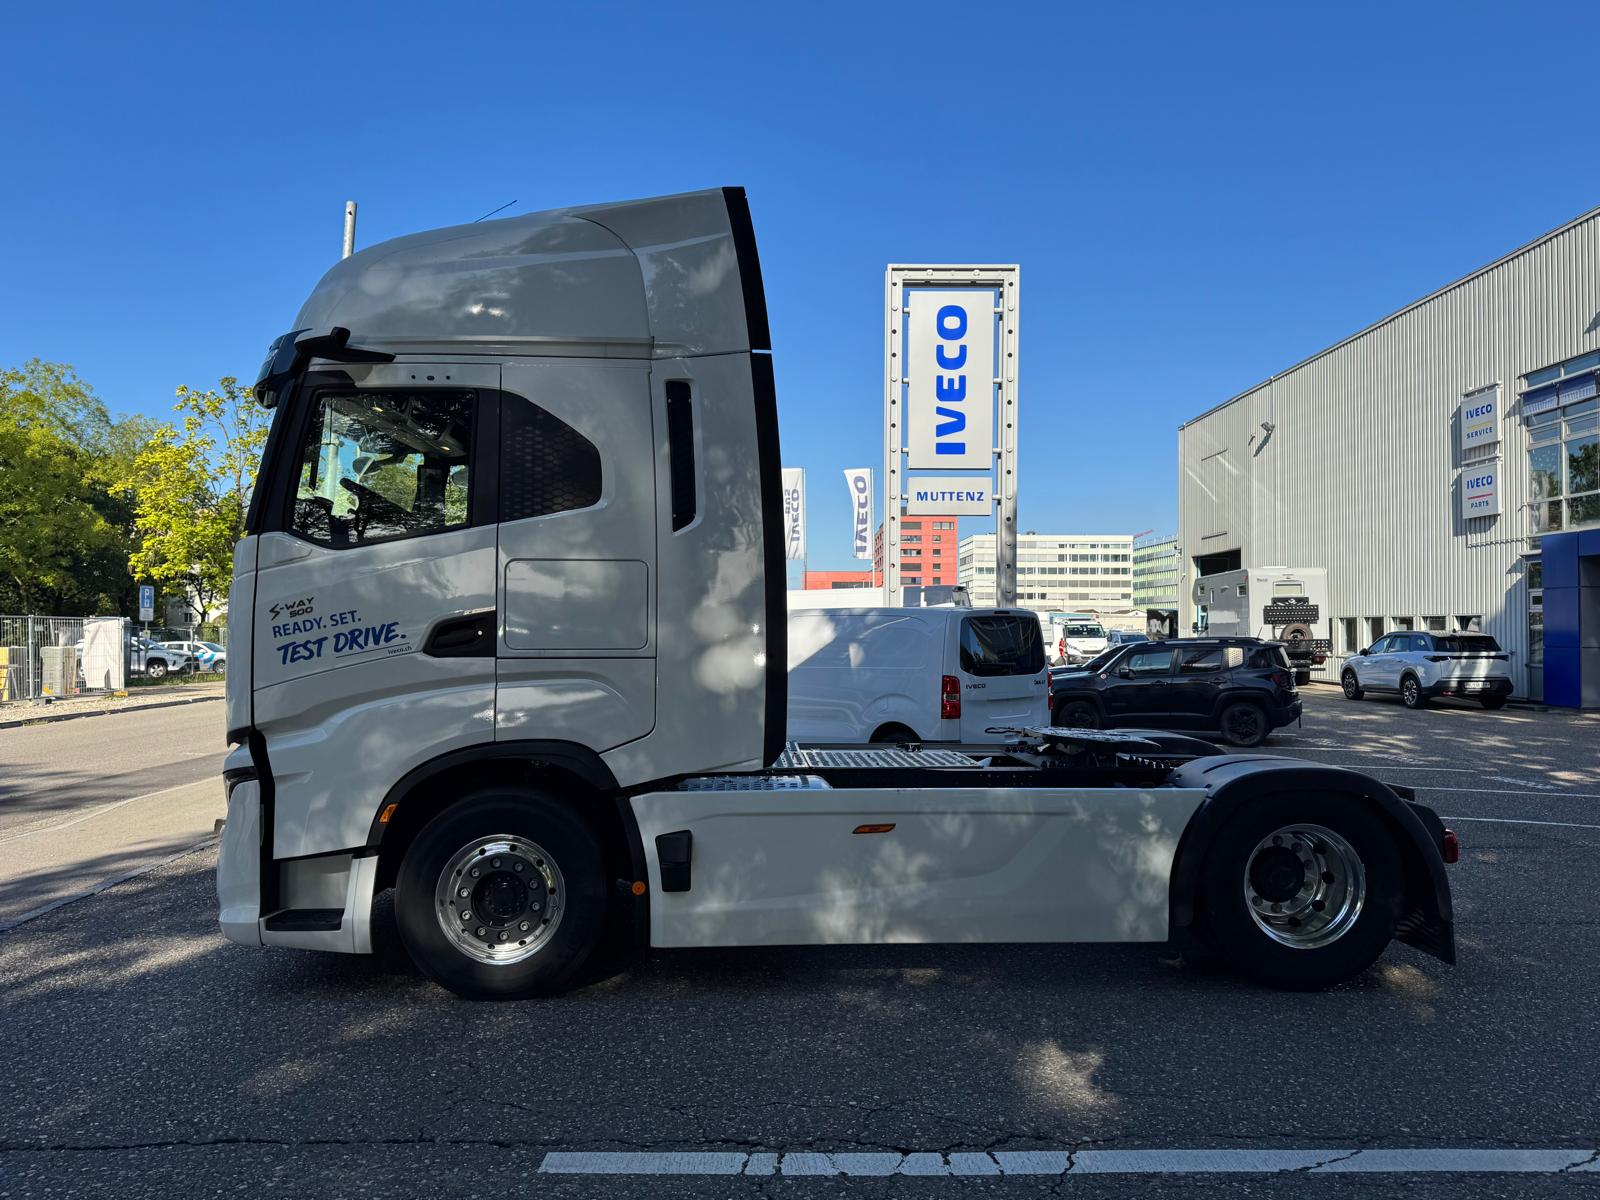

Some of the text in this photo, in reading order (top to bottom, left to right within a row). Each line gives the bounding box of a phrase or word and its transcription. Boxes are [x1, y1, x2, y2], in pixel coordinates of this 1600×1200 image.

[936, 305, 967, 455] IVECO
[1466, 404, 1492, 419] IVECO
[1466, 426, 1493, 440] SERVICE
[1466, 475, 1493, 490] IVECO
[916, 491, 985, 502] MUTTENZ
[1470, 500, 1489, 509] PARTS
[269, 597, 314, 621] S-WAY
[289, 606, 313, 618] 500
[272, 610, 362, 638] READY. SET.
[276, 622, 407, 665] TEST DRIVE.
